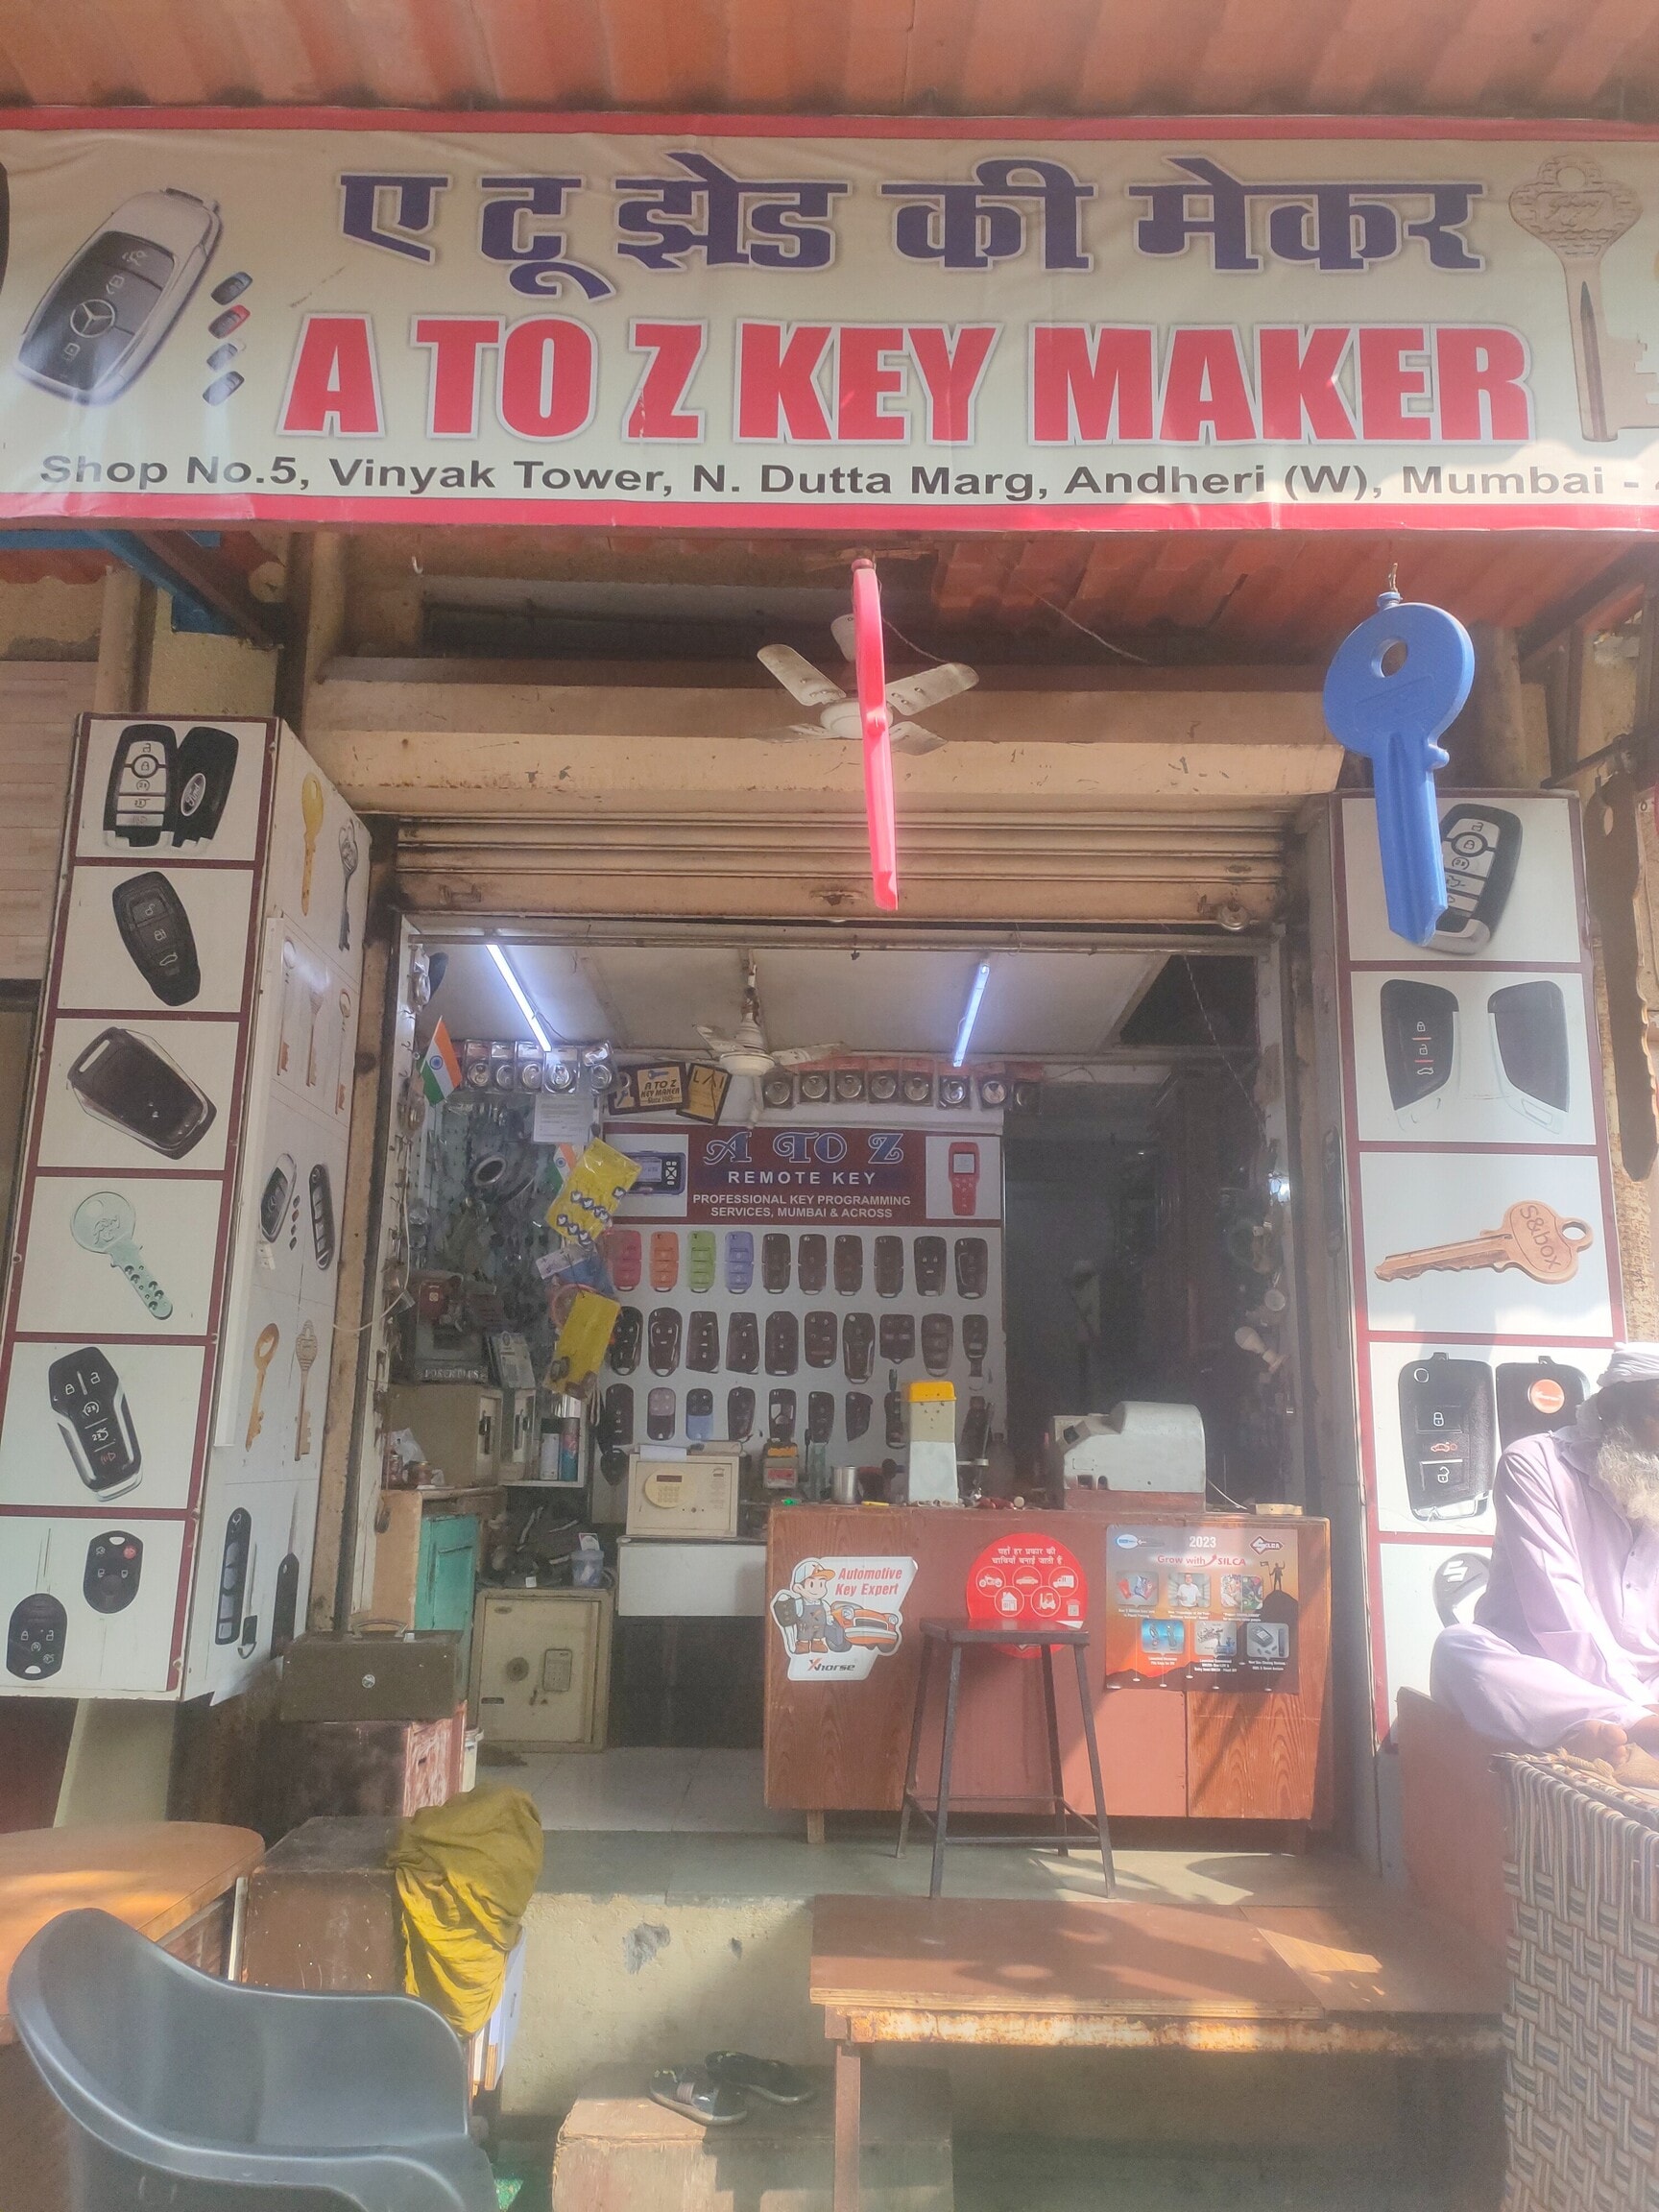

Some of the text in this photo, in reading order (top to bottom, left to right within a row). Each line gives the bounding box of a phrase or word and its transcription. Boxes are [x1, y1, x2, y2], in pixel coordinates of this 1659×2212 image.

[340, 152, 1485, 300] ए टू झेड की मेकर
[285, 317, 1531, 443] A TO Z KEY MAKER
[40, 456, 168, 491] Shop
[187, 457, 309, 492] No.5,
[329, 458, 495, 495] Vinyak
[514, 461, 673, 498] Tower,
[694, 465, 740, 493] N.
[761, 465, 893, 495] Dutta
[912, 467, 1048, 502] Marg,
[1065, 466, 1265, 495] Andheri
[1286, 466, 1380, 500] (W),
[1404, 466, 1604, 495] Mumbai
[645, 1079, 677, 1091] A TO Z
[640, 1088, 681, 1098] KEY MAKER
[704, 1131, 904, 1165] A TO Z
[728, 1170, 876, 1185] REMOTE KEY
[692, 1194, 911, 1206] PROFESSIONAL KEY PROGRAMMING
[710, 1207, 893, 1218] SERVICES, MUMBAI & ACROSS
[1189, 1536, 1217, 1549] 2023
[1157, 1554, 1246, 1567] Grow with SILCA
[837, 1567, 902, 1580] Automotive
[834, 1583, 899, 1597] Key Expert
